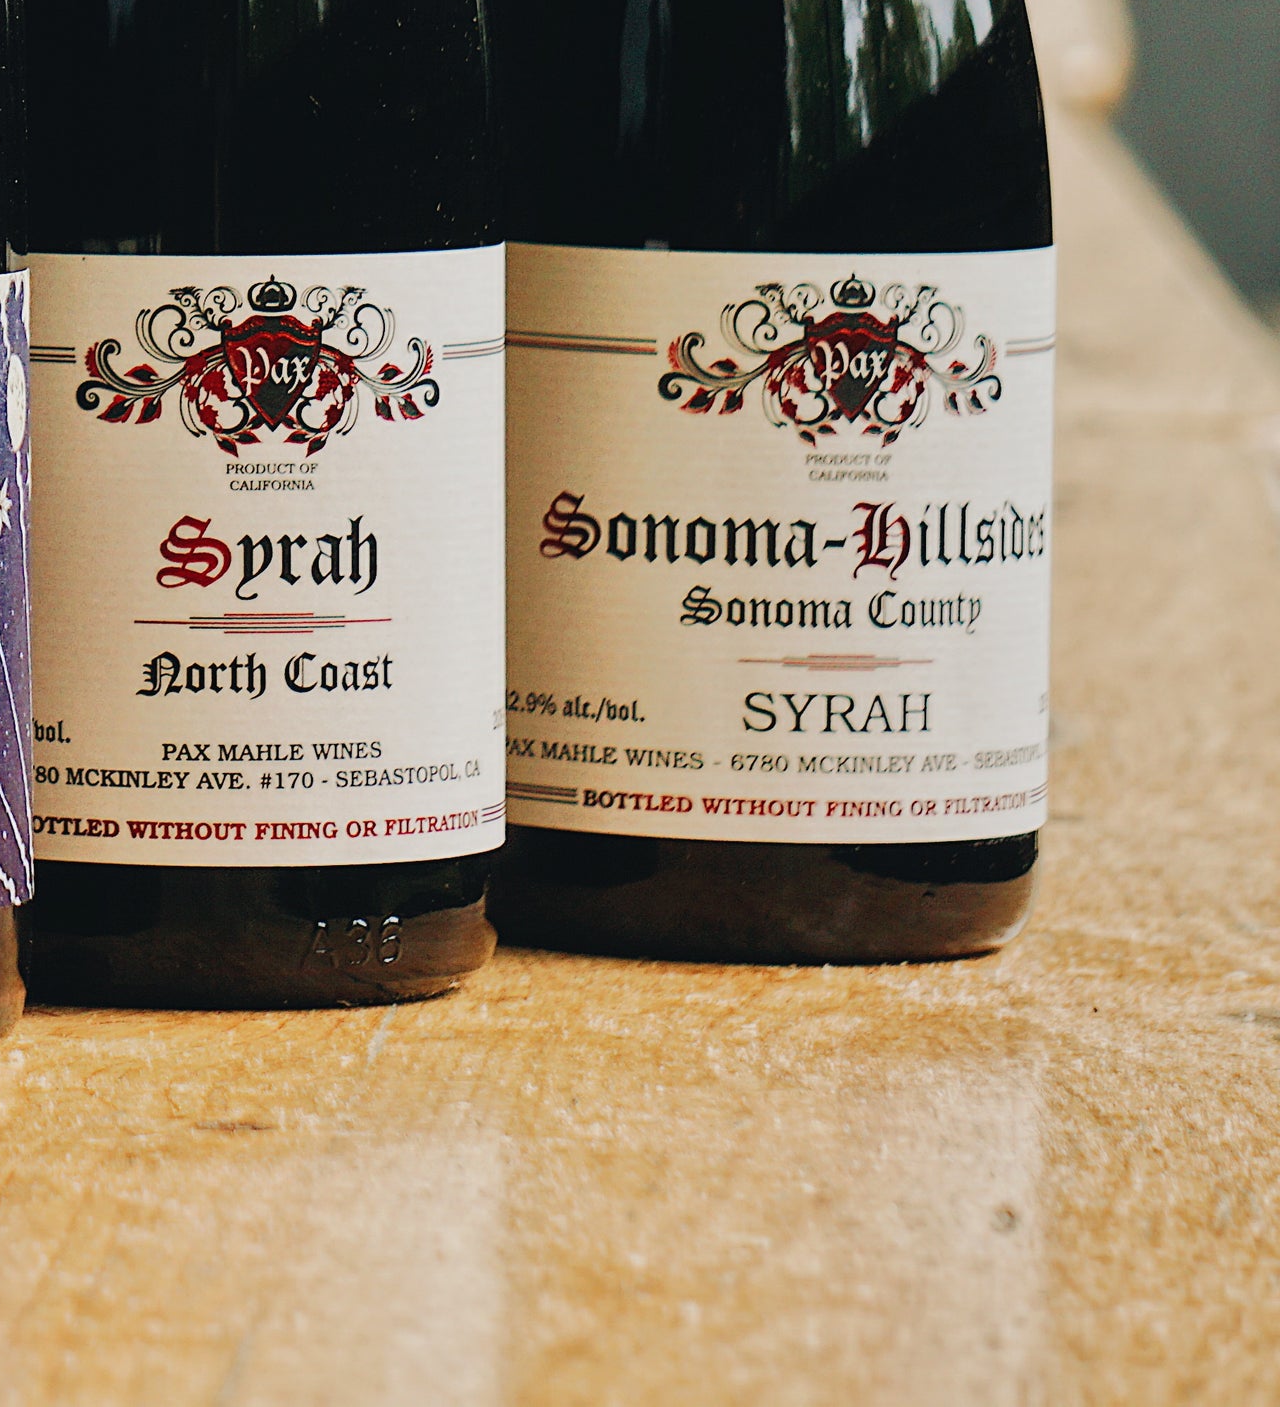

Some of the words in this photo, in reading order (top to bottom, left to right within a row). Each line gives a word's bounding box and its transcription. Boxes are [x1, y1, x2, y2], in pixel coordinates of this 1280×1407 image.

[237, 342, 313, 397] Pax
[810, 339, 890, 390] Pax
[226, 463, 296, 476] PRODUCT
[299, 462, 319, 475] OF
[805, 454, 871, 467] PRODUCT
[808, 470, 890, 483] CALIFORNIA
[229, 479, 316, 492] CALIFORNIA
[156, 513, 379, 601] Syrah
[679, 585, 852, 631] Sonoma
[868, 589, 983, 635] County
[136, 649, 268, 699] North
[283, 650, 394, 694] Coast
[742, 692, 933, 733] SYRAH
[32, 717, 72, 744] vol.
[162, 743, 211, 762] PAX
[217, 742, 305, 763] MAHLE
[311, 740, 383, 760] WINES
[540, 741, 618, 765] MAHLE
[623, 748, 705, 772] WINES
[729, 752, 790, 774] 6780
[797, 754, 915, 774] MCKINLEY
[33, 765, 60, 785] 80
[65, 767, 190, 790] MCKINLEY
[196, 770, 251, 791] AVE.
[260, 769, 315, 790] #170
[464, 759, 481, 779] CA
[582, 788, 693, 815] BOTTLED
[701, 796, 819, 819] WITHOUT
[825, 798, 903, 820] FINING
[910, 799, 937, 817] OR
[943, 792, 1028, 816] FILTRATION
[32, 814, 121, 839] OTTLED
[126, 820, 247, 842] WITHOUT
[254, 820, 339, 842] FINING
[345, 820, 378, 840] OR
[384, 809, 480, 837] FILTRATION
